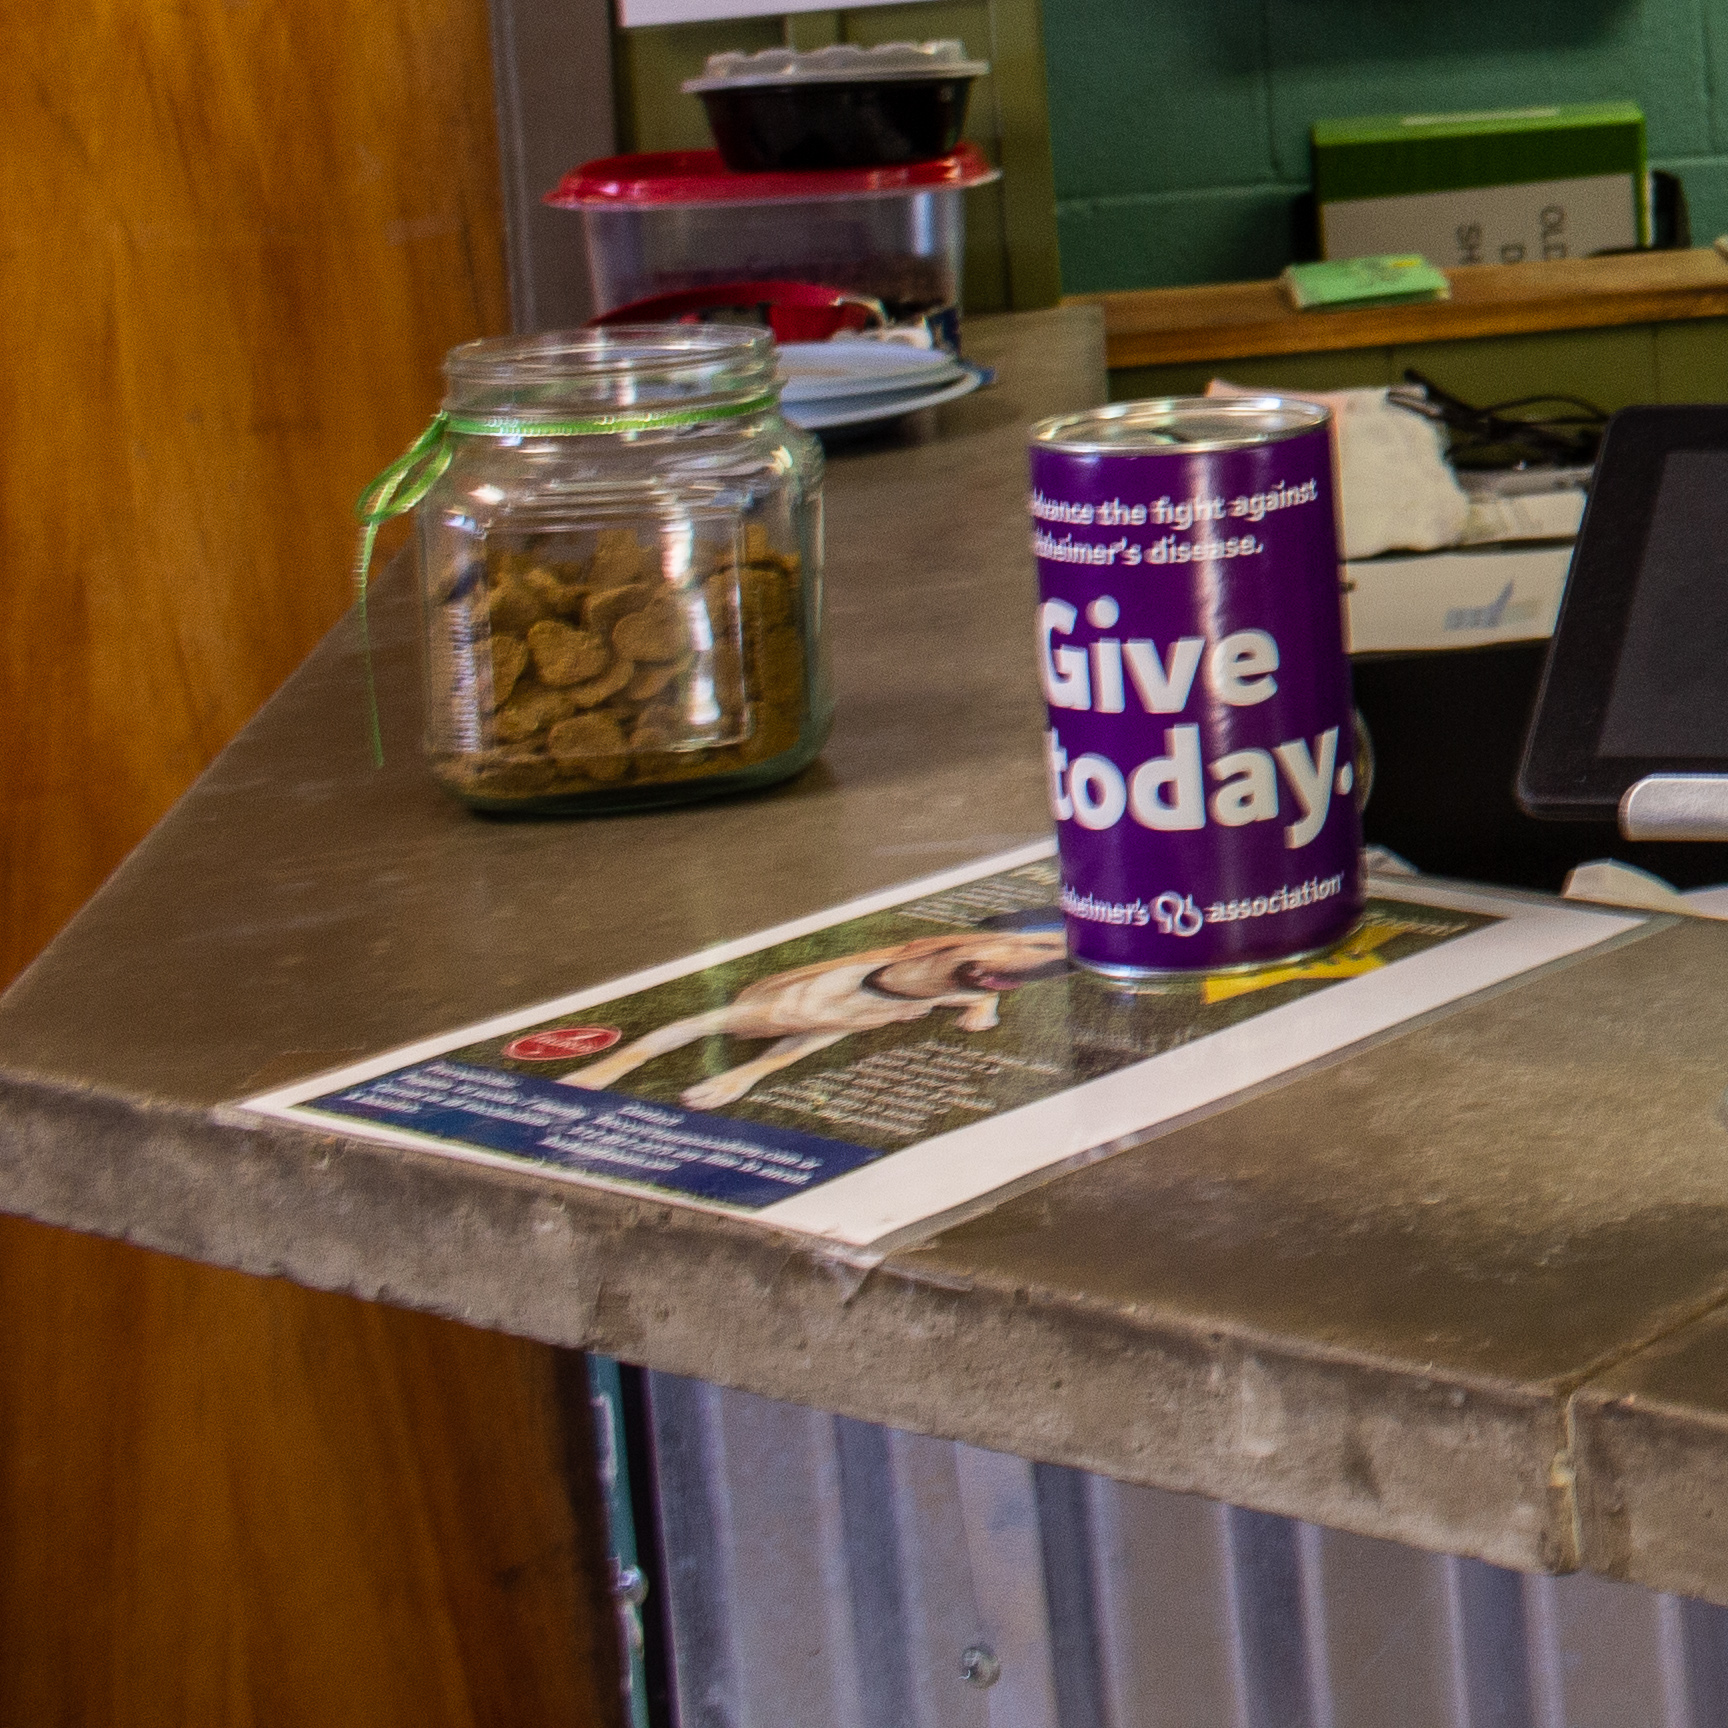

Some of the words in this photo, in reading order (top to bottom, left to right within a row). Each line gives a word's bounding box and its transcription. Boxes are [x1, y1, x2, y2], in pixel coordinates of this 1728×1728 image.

[1097, 497, 1147, 525] the
[1150, 495, 1225, 530] fight
[1229, 478, 1318, 521] against
[1145, 534, 1264, 564] disease.
[1038, 594, 1279, 714] Give
[1046, 722, 1353, 849] today.
[1204, 872, 1344, 922] association
